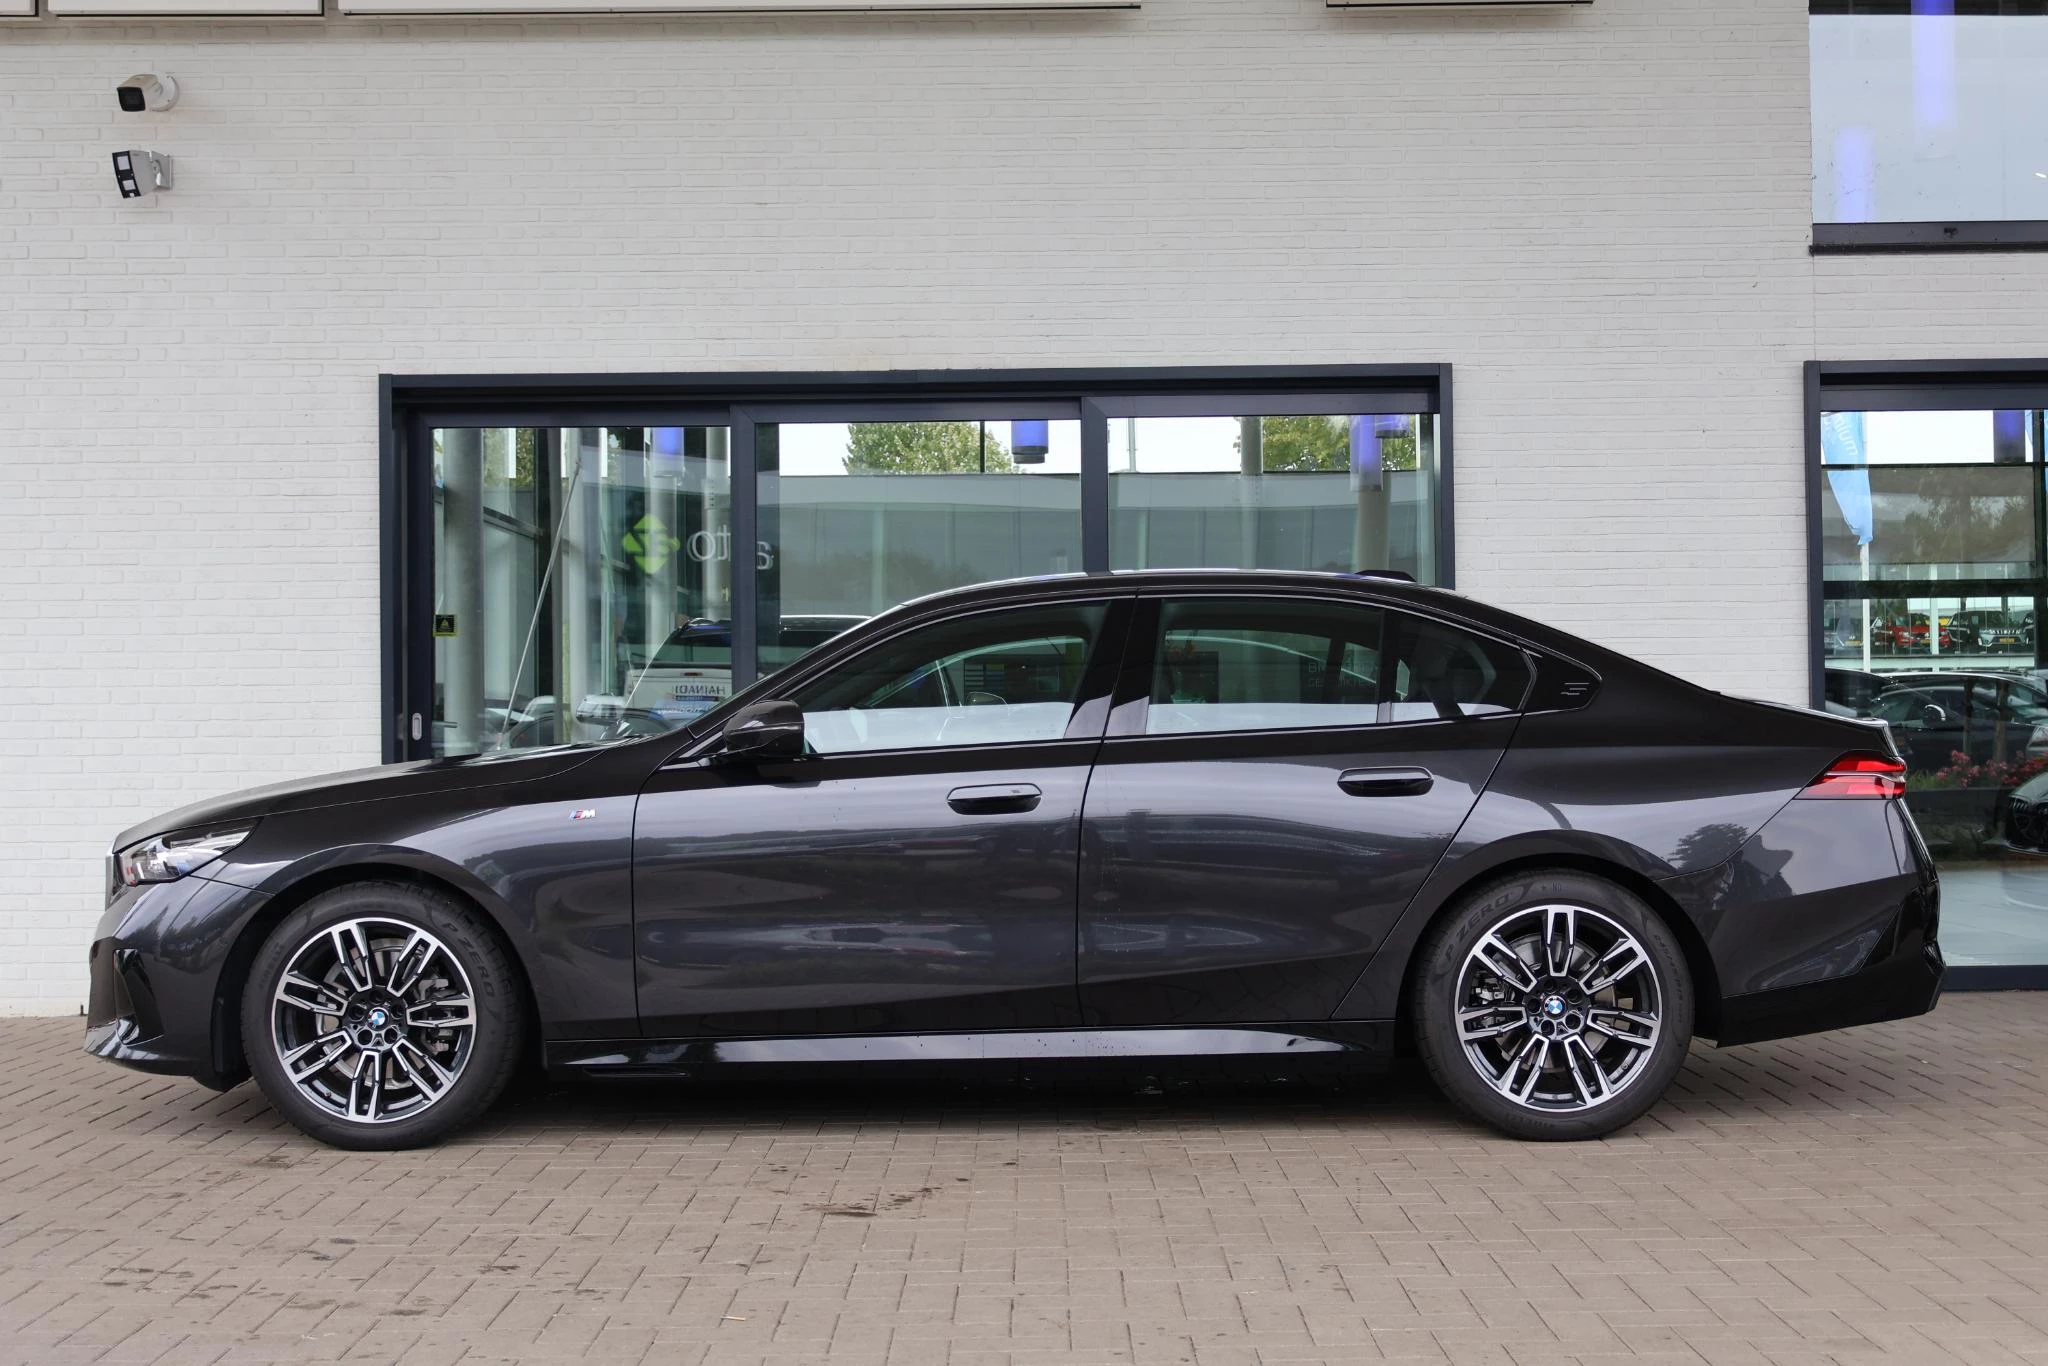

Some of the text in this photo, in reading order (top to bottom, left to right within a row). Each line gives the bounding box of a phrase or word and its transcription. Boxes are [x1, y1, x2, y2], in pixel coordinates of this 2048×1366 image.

[441, 922, 495, 997] P ZERO
[1445, 892, 1511, 961] P ZERO
